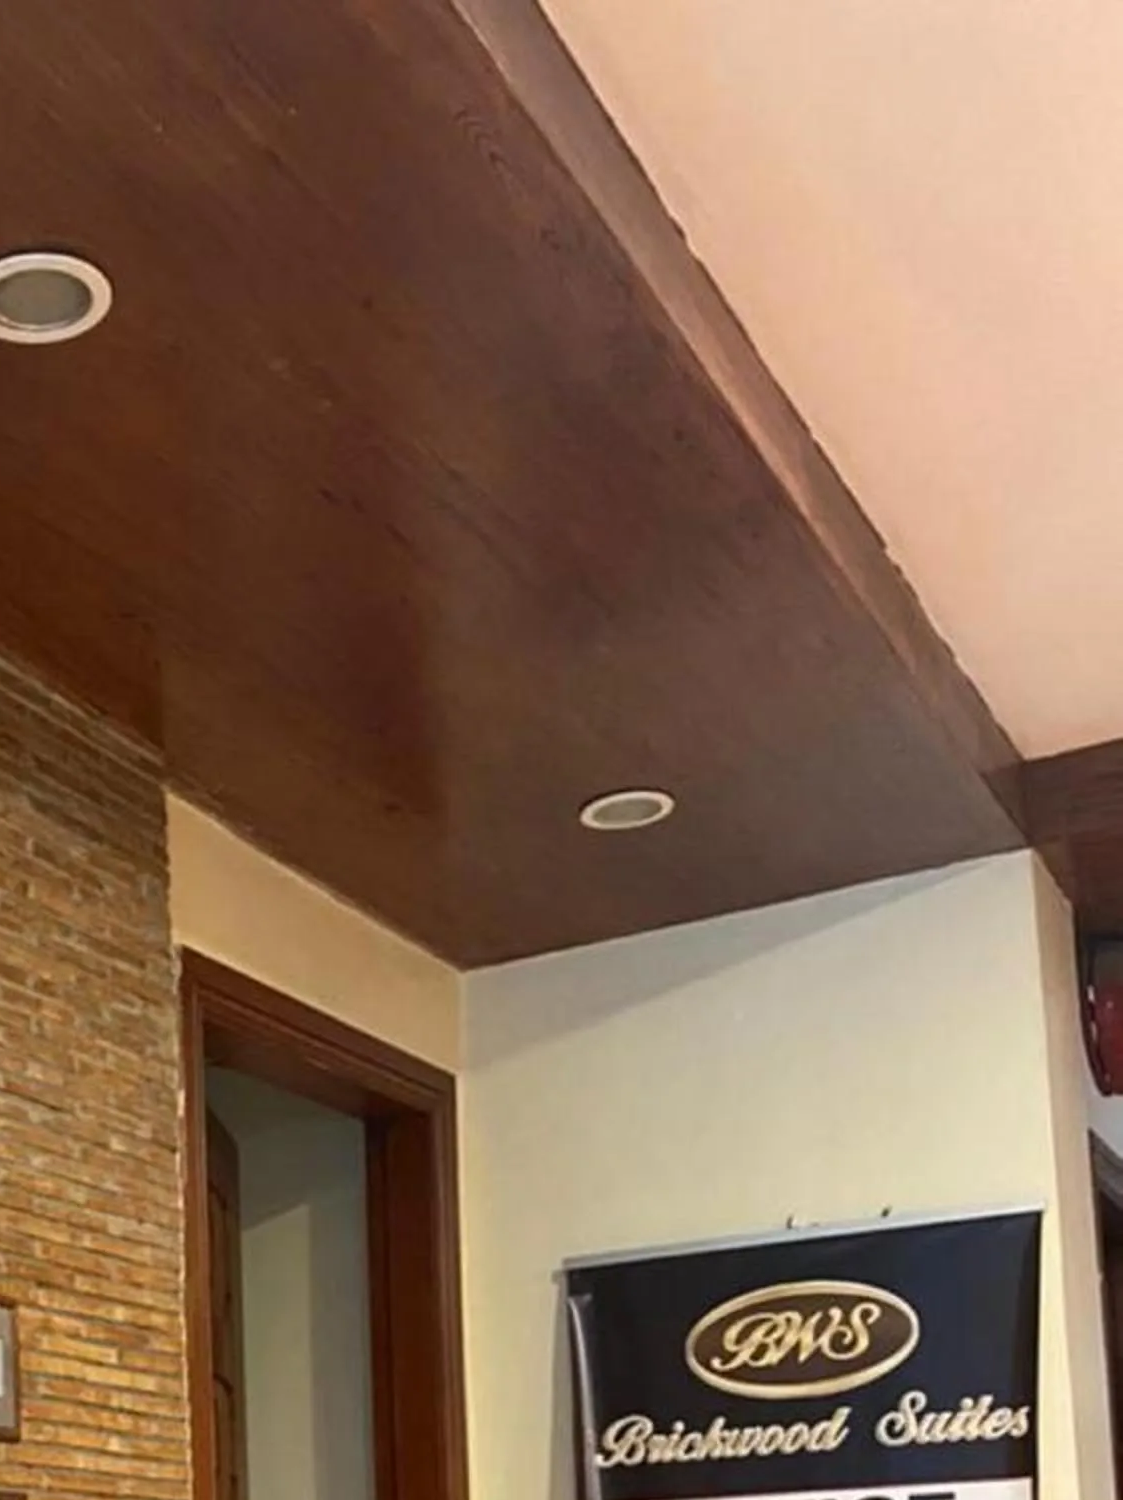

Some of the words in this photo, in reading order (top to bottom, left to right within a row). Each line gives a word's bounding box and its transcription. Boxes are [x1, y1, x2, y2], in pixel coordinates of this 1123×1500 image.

[709, 1301, 882, 1371] BWS
[596, 1406, 852, 1468] Brickwood
[875, 1390, 1031, 1449] Suites
